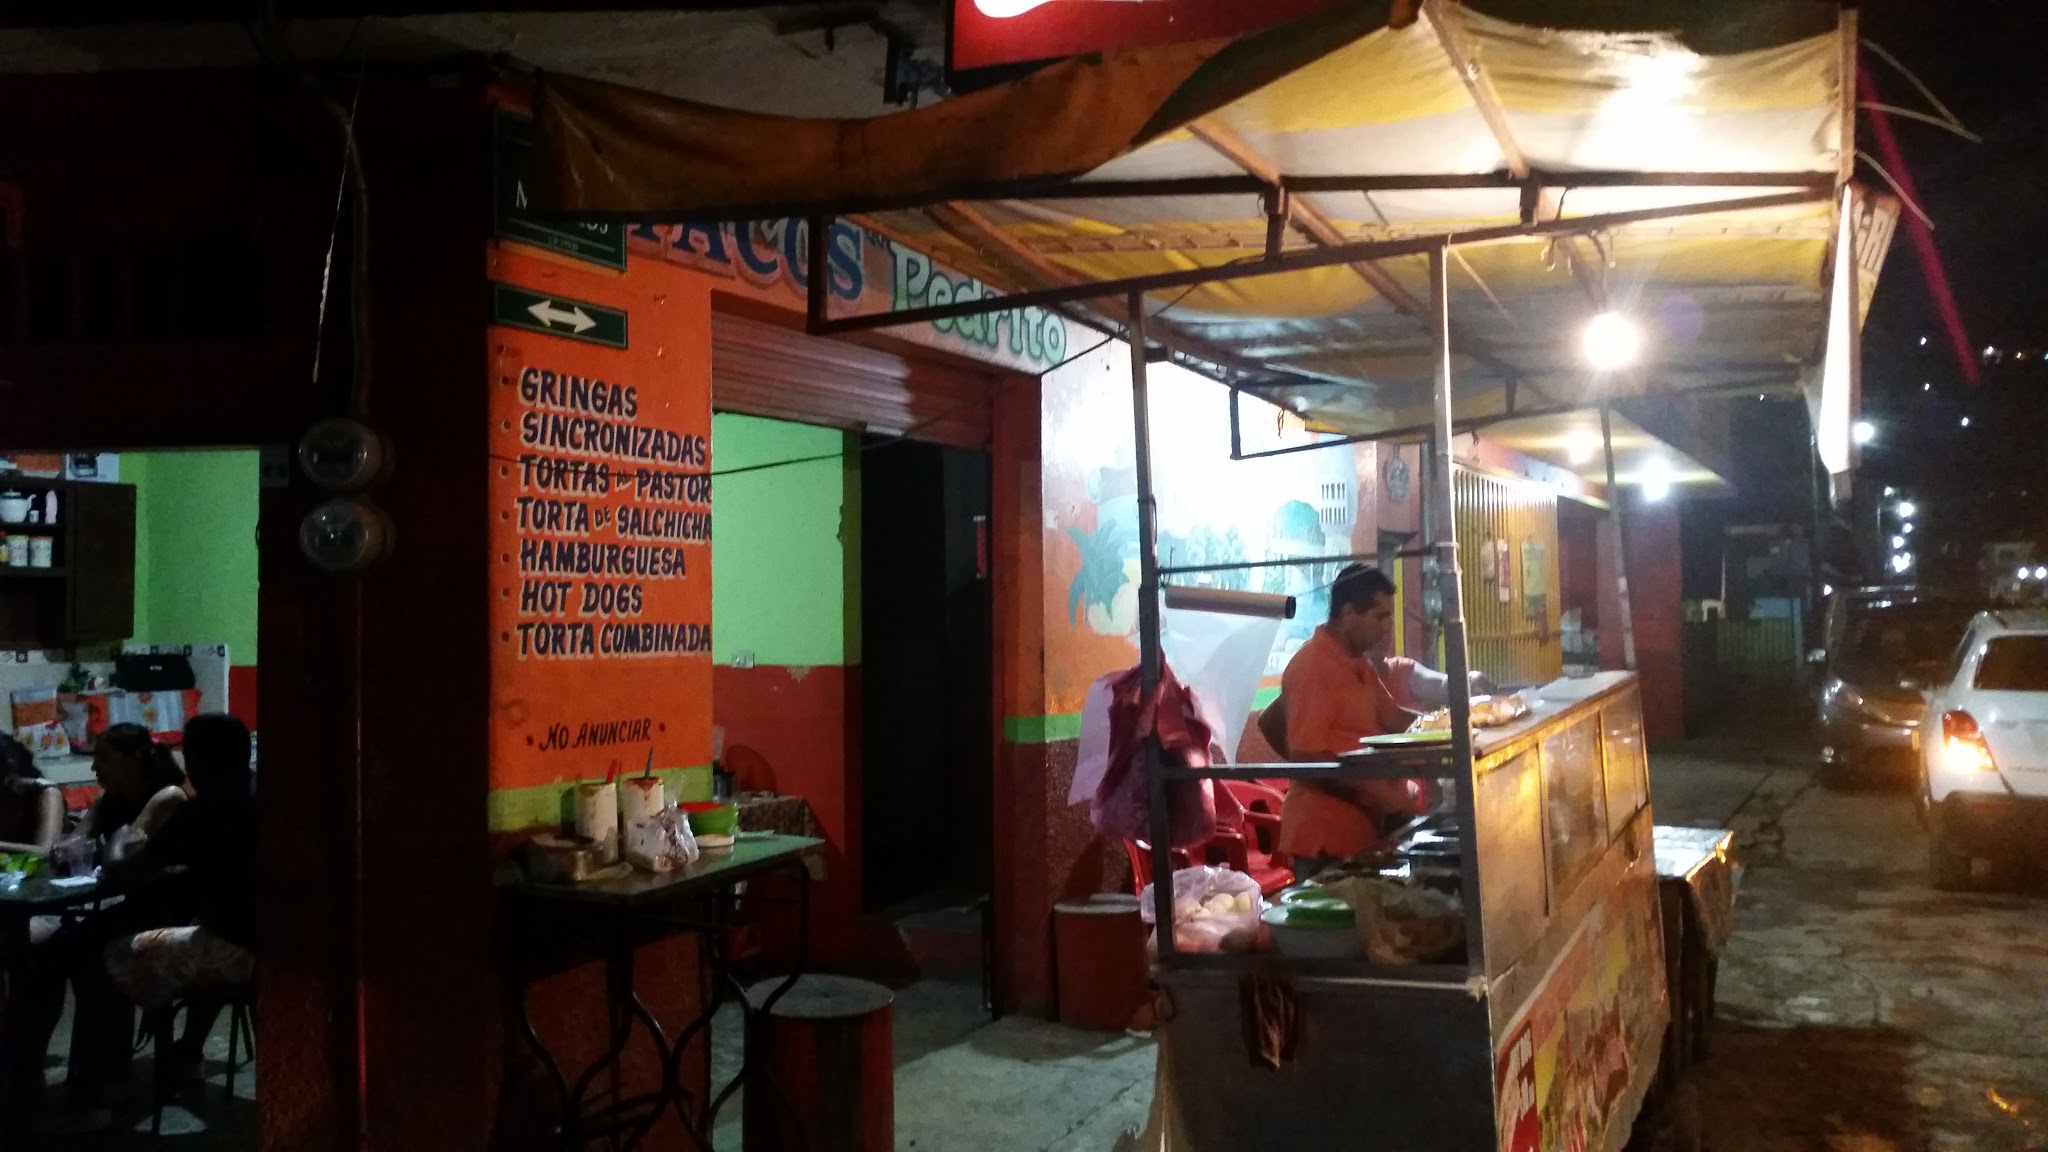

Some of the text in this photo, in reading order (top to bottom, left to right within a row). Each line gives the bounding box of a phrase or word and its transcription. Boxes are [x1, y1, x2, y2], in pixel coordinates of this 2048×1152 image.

[518, 366, 638, 419] GRINGAS
[519, 411, 706, 467] SINCRONIZADAS
[516, 454, 610, 497] TORTAS
[634, 468, 712, 504] PASTOR
[515, 496, 712, 546] TORTA DE SALCHICHA
[518, 538, 686, 579] HAMBURGUESA
[518, 579, 643, 618] HOT DOGS
[515, 621, 711, 660] TORTA COMBINADA
[539, 717, 651, 751] NO ANUNCIAR
